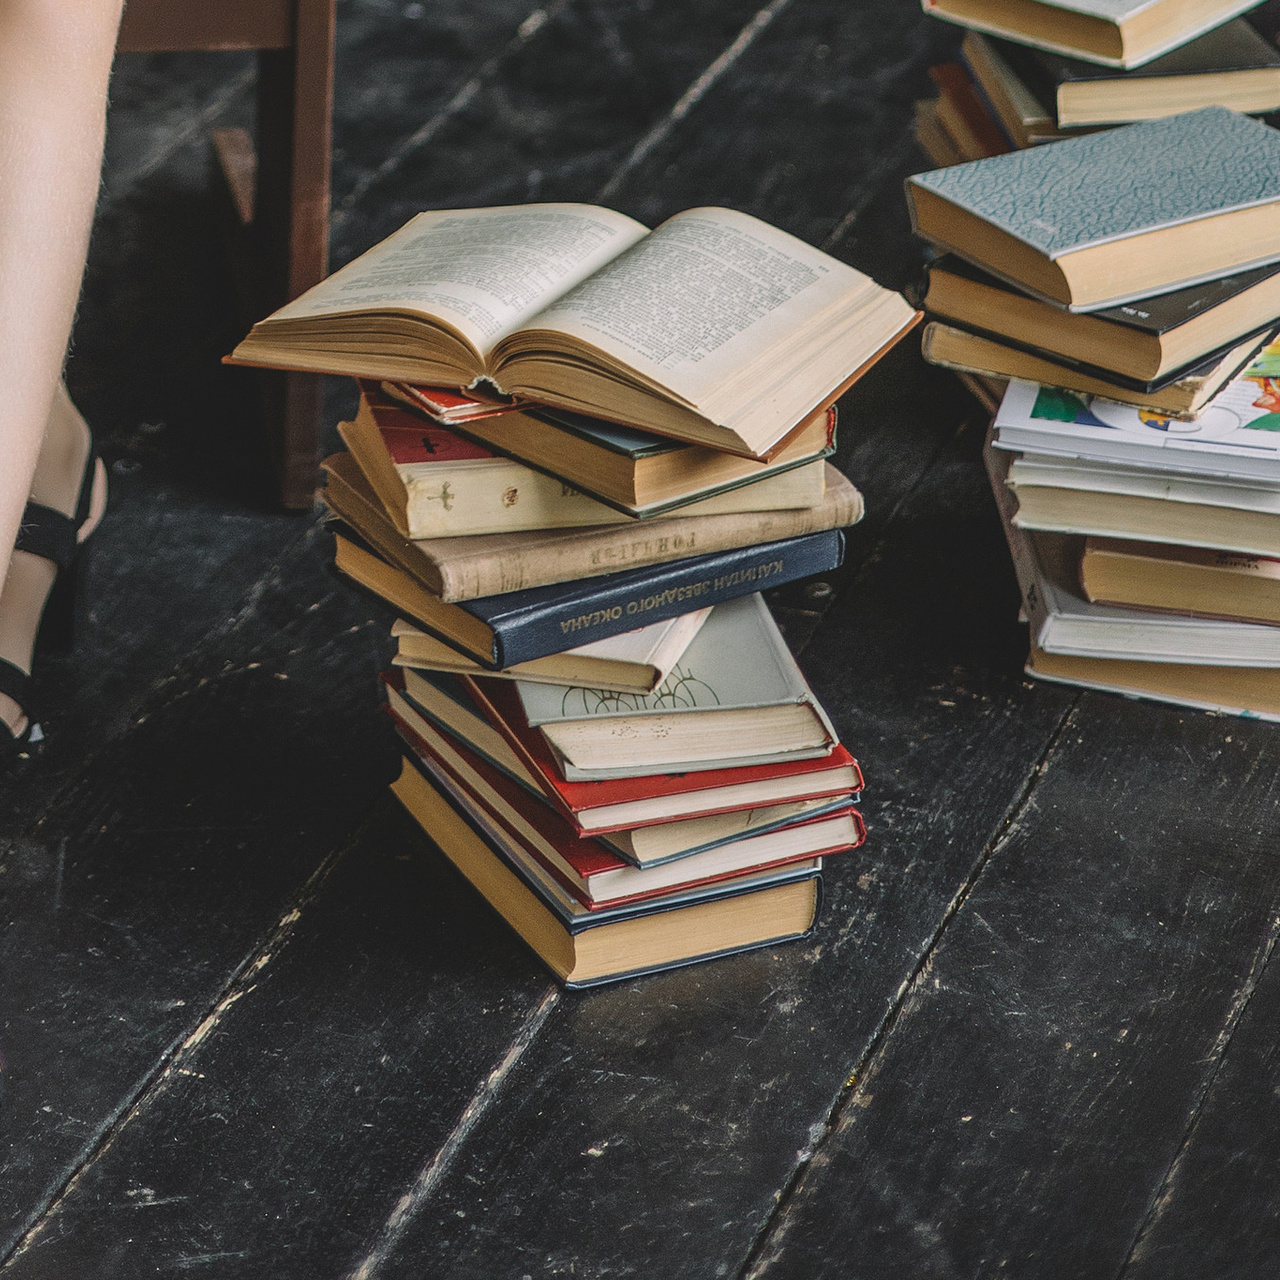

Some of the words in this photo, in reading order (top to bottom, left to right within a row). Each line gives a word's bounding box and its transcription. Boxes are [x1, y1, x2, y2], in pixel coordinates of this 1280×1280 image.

[713, 559, 783, 588] КАПИТАН
[625, 581, 712, 614] ЗВЕЗДНОГО
[560, 607, 623, 635] ОКЕАНА
